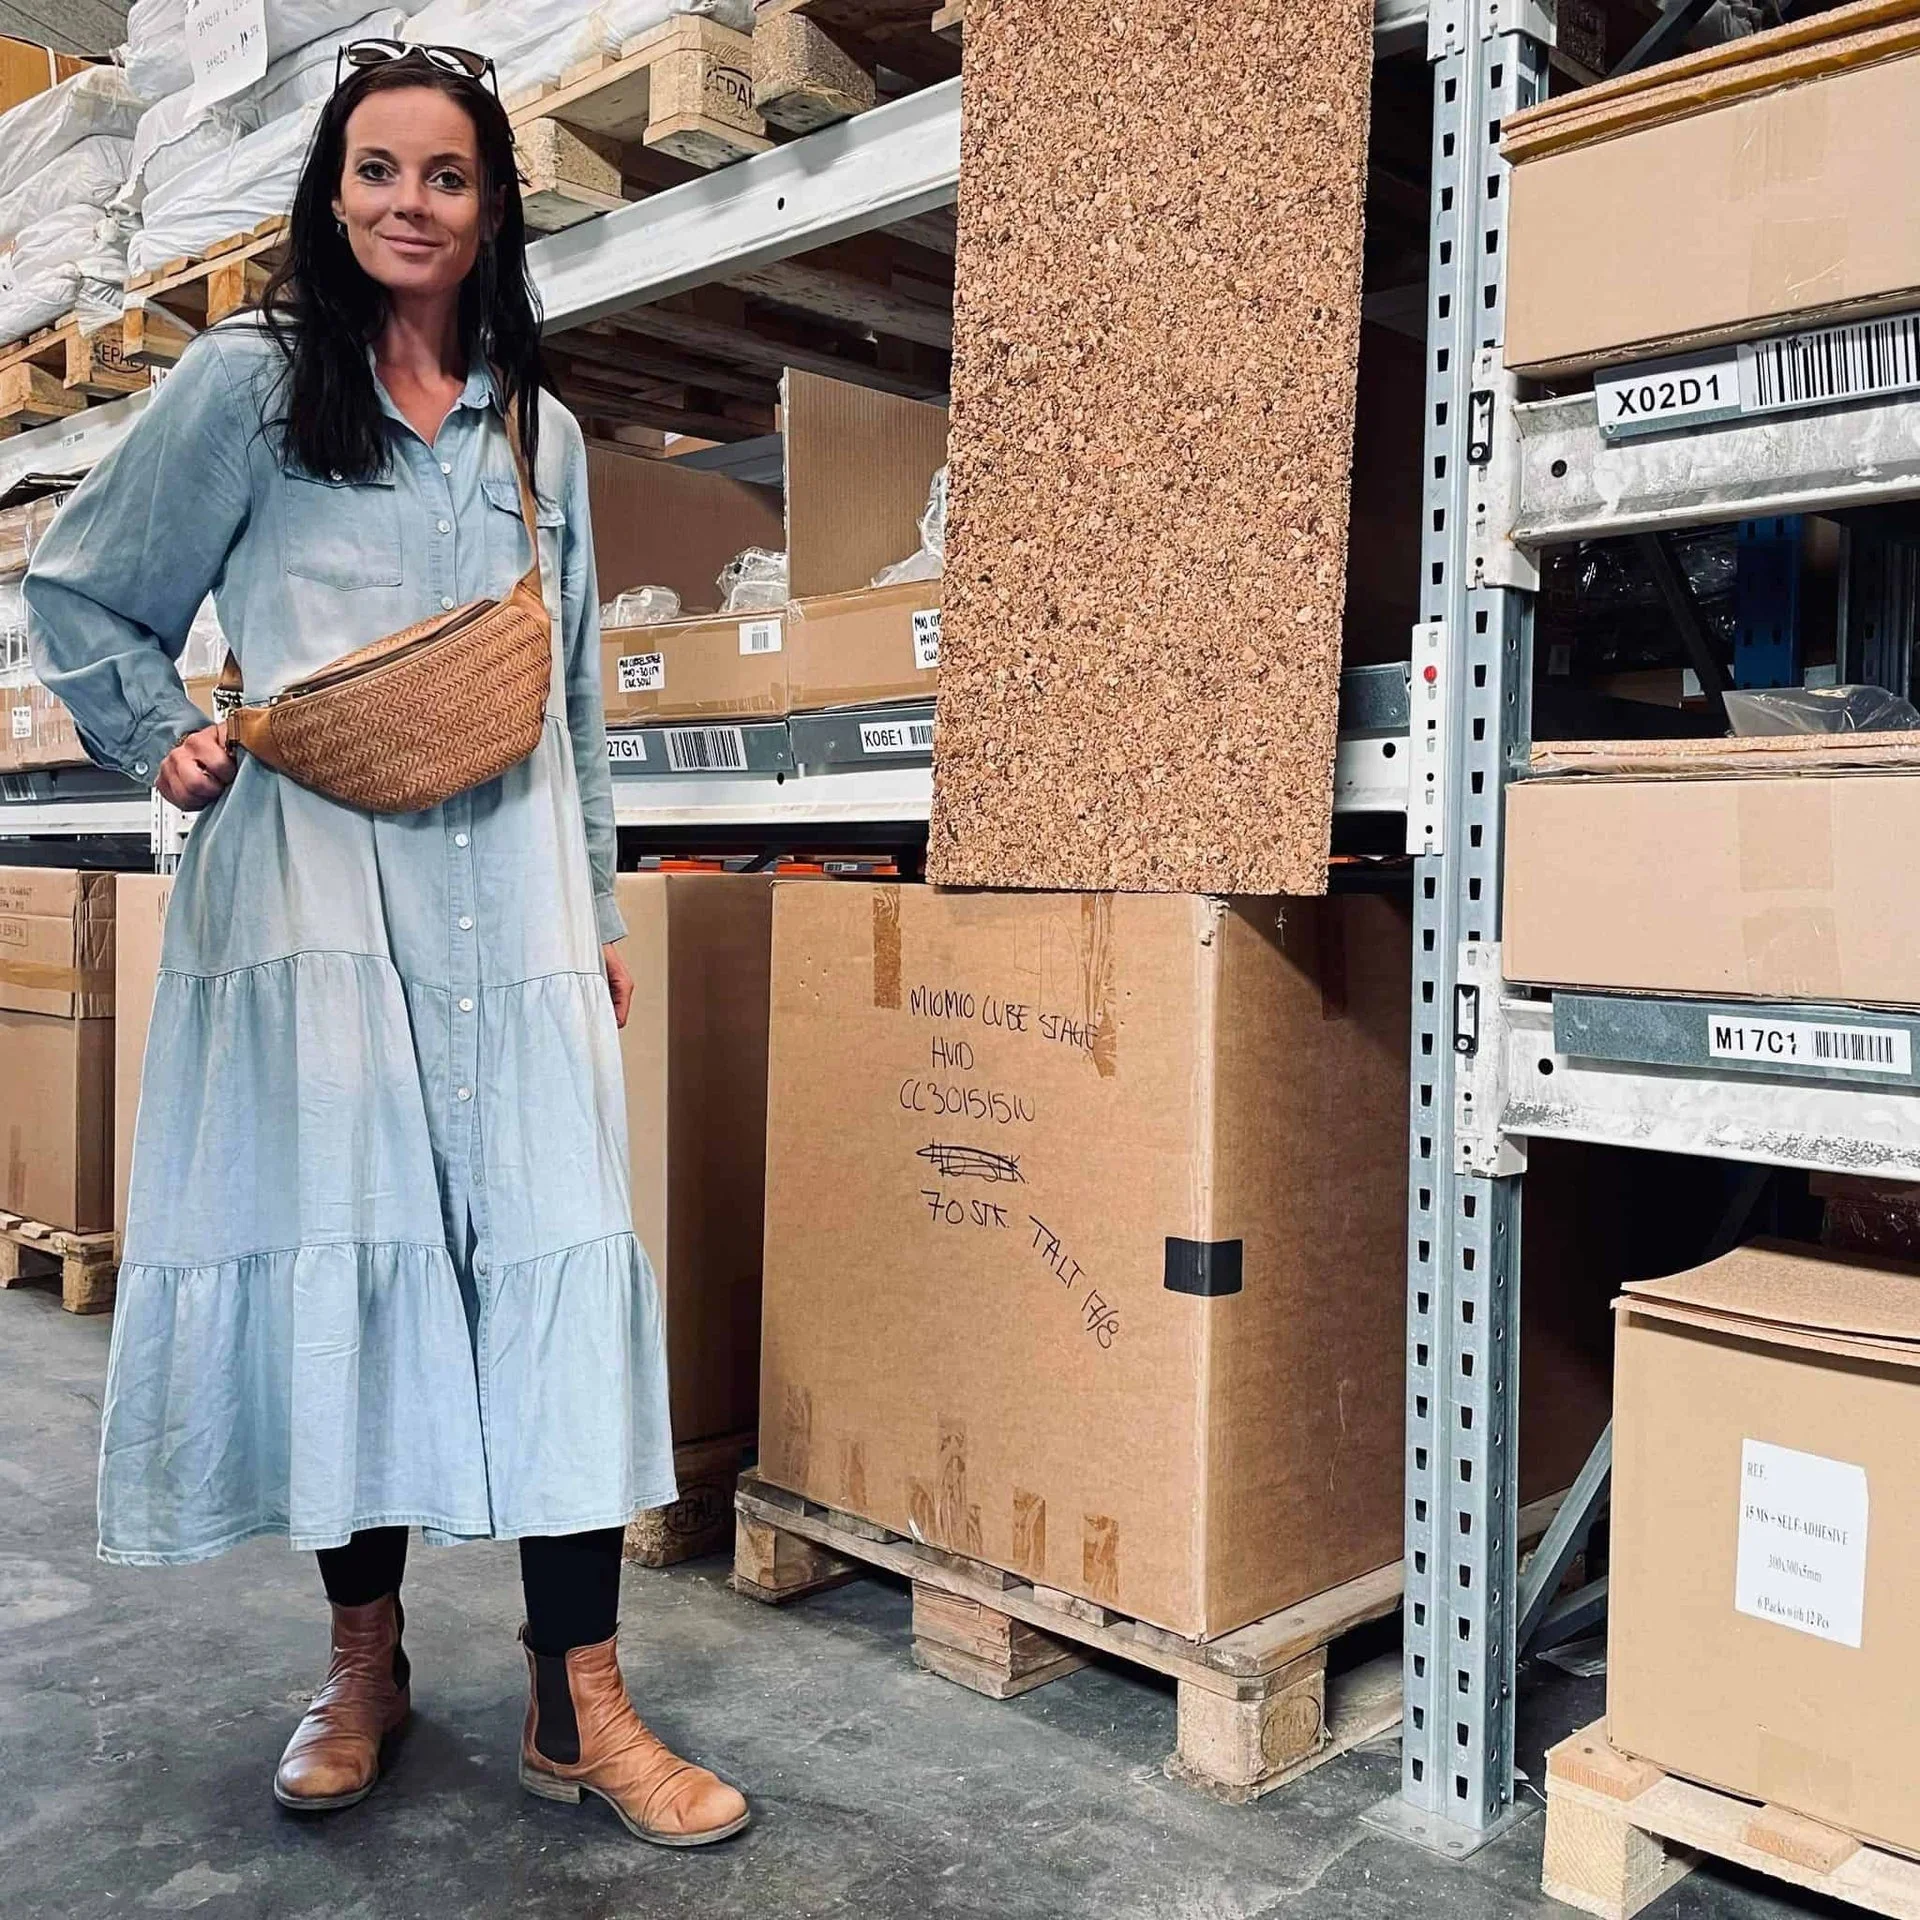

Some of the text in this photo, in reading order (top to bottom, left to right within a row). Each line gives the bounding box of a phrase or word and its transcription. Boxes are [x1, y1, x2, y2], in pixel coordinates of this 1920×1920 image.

[1615, 374, 1720, 417] X02D1
[864, 728, 903, 747] K06E1
[982, 994, 1032, 1033] CUBE
[931, 1035, 974, 1071] HVID
[1715, 1026, 1797, 1056] M17C1
[920, 1189, 965, 1225] 70
